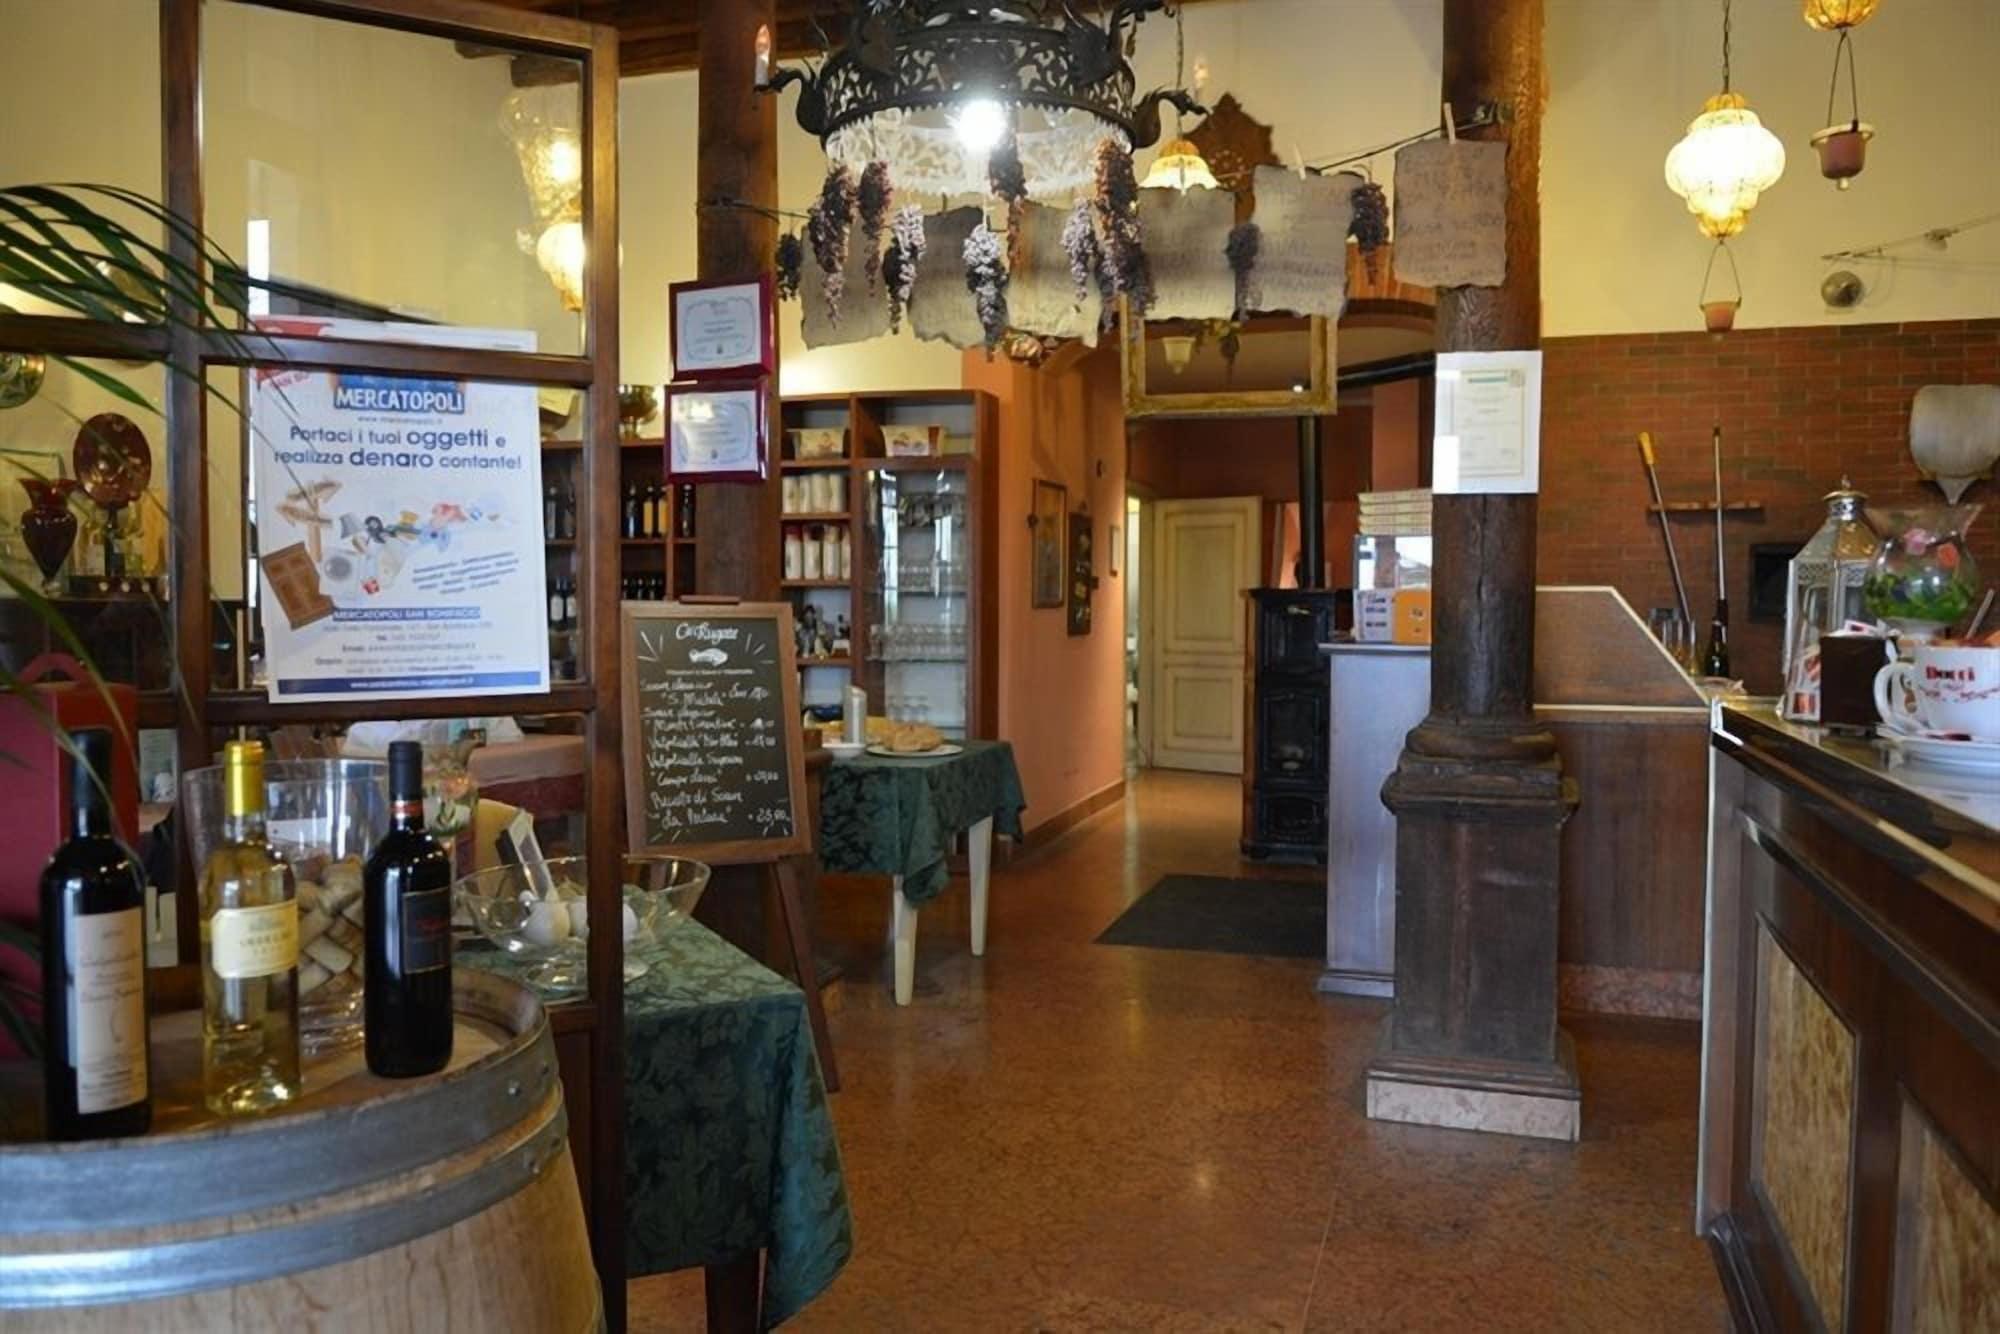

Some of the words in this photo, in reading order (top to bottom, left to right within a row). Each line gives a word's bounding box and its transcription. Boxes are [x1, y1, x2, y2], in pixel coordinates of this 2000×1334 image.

[335, 387, 463, 412] MERCATOPOLI
[290, 425, 352, 443] Portaci
[358, 428, 364, 444] i
[369, 429, 401, 445] tuoi
[406, 428, 489, 450] oggetti
[495, 436, 506, 448] e
[274, 449, 344, 466] realizza
[350, 449, 434, 468] denaro
[439, 454, 523, 470] contante!
